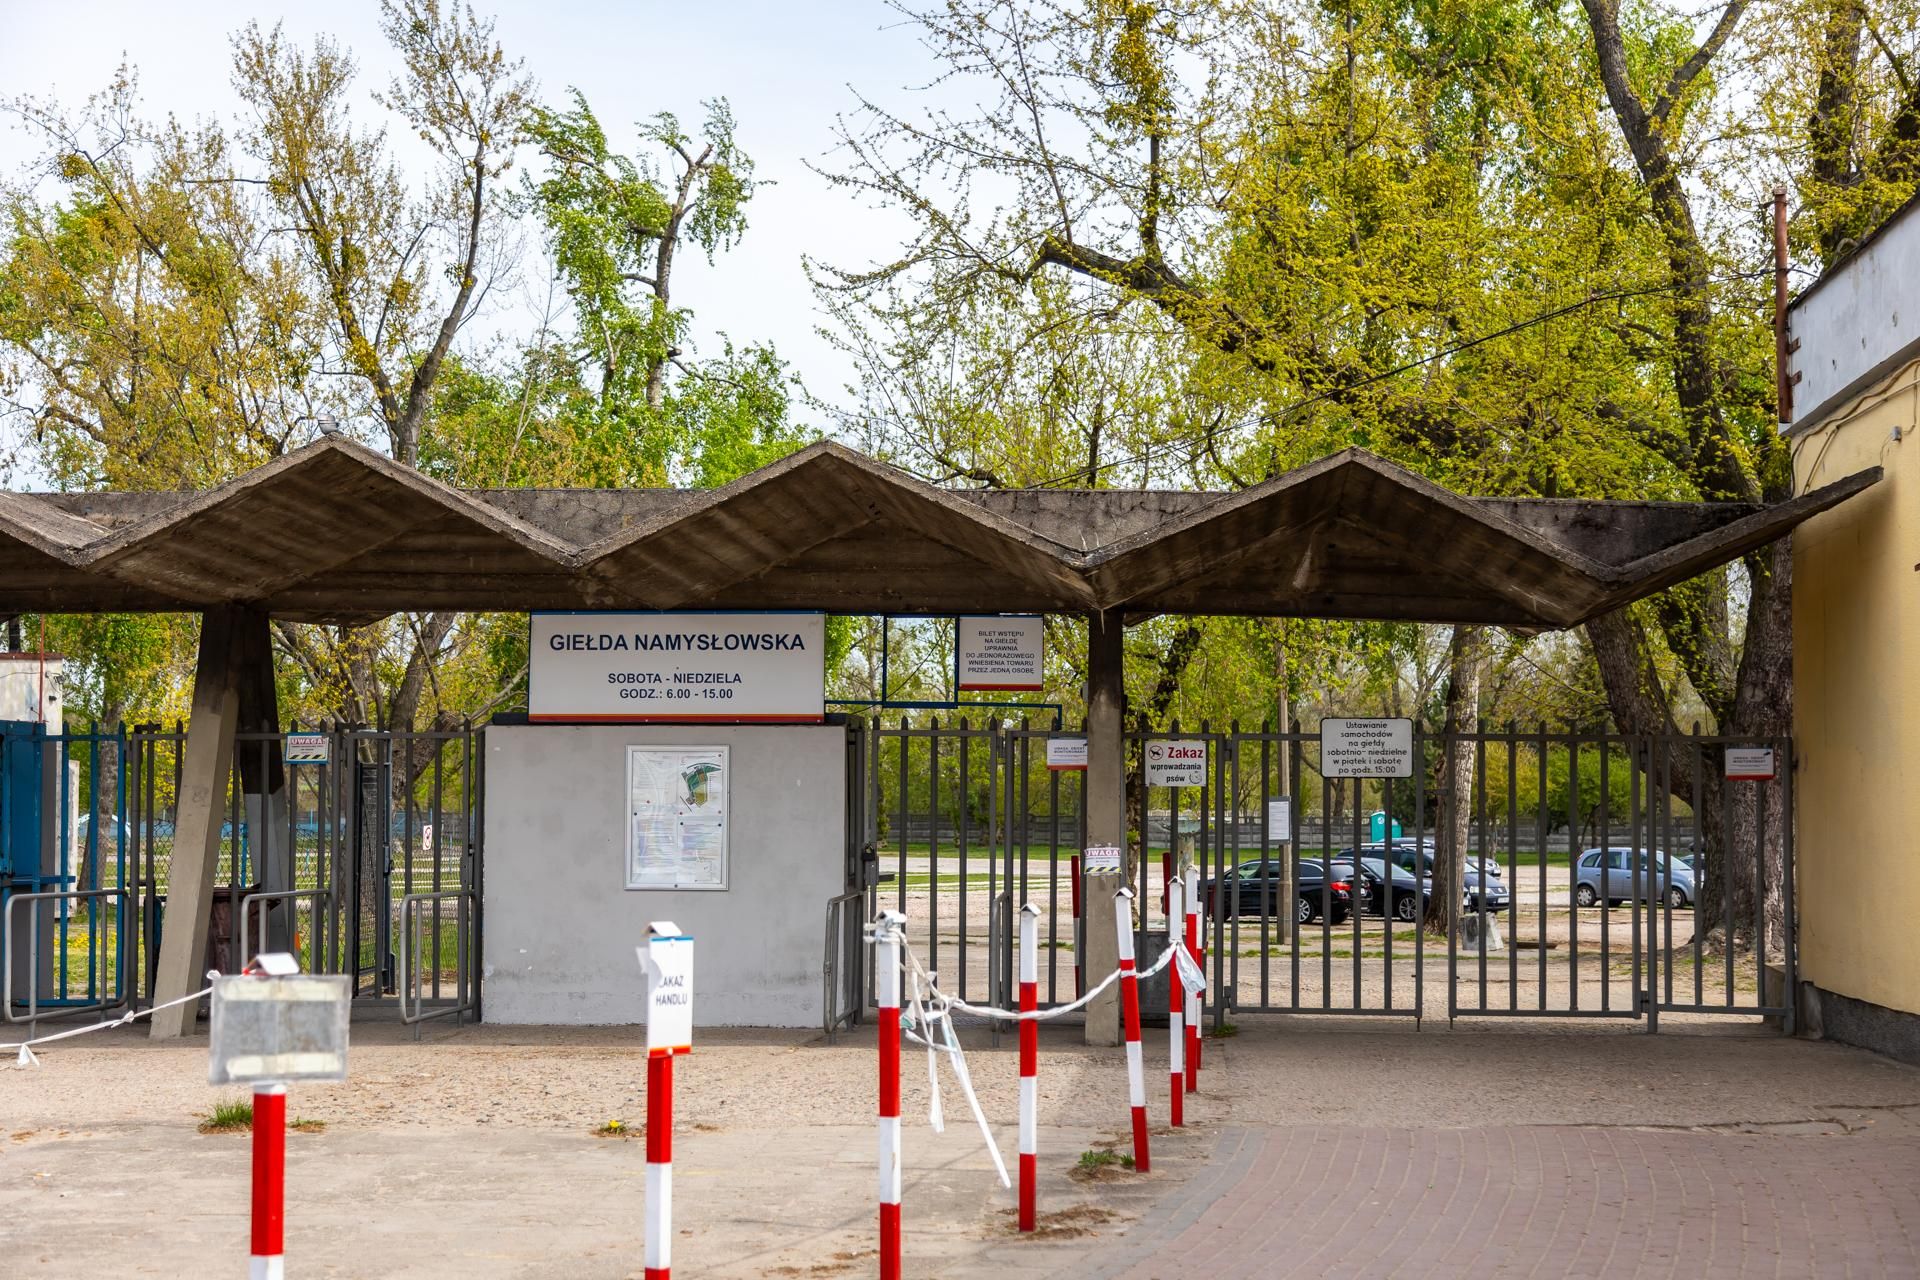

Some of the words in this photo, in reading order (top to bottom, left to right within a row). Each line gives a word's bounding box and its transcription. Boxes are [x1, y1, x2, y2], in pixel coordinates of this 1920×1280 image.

[549, 634, 629, 651] GIEŁDA
[634, 634, 806, 651] NAMYSŁOWSKA
[989, 667, 1011, 675] JEDNĄ
[608, 673, 662, 684] SOBOTA
[673, 673, 742, 684] NIEDZIELA
[620, 688, 663, 699] GODZ.:
[666, 688, 691, 699] 6.00
[702, 688, 733, 699] 15.00
[1345, 721, 1388, 729] Ustawianie
[1340, 730, 1393, 738] samochodów
[1360, 739, 1386, 749] giełdy
[1167, 746, 1204, 759] Zakaz
[1368, 748, 1408, 756] niedzielne
[1150, 762, 1202, 772] wprowadzania
[1338, 767, 1350, 775] po
[1351, 766, 1374, 775] godz.
[1375, 765, 1396, 774] 15:00
[1166, 774, 1186, 784] psów
[659, 975, 684, 988] AKAZ
[656, 994, 688, 1005] HANDLU
